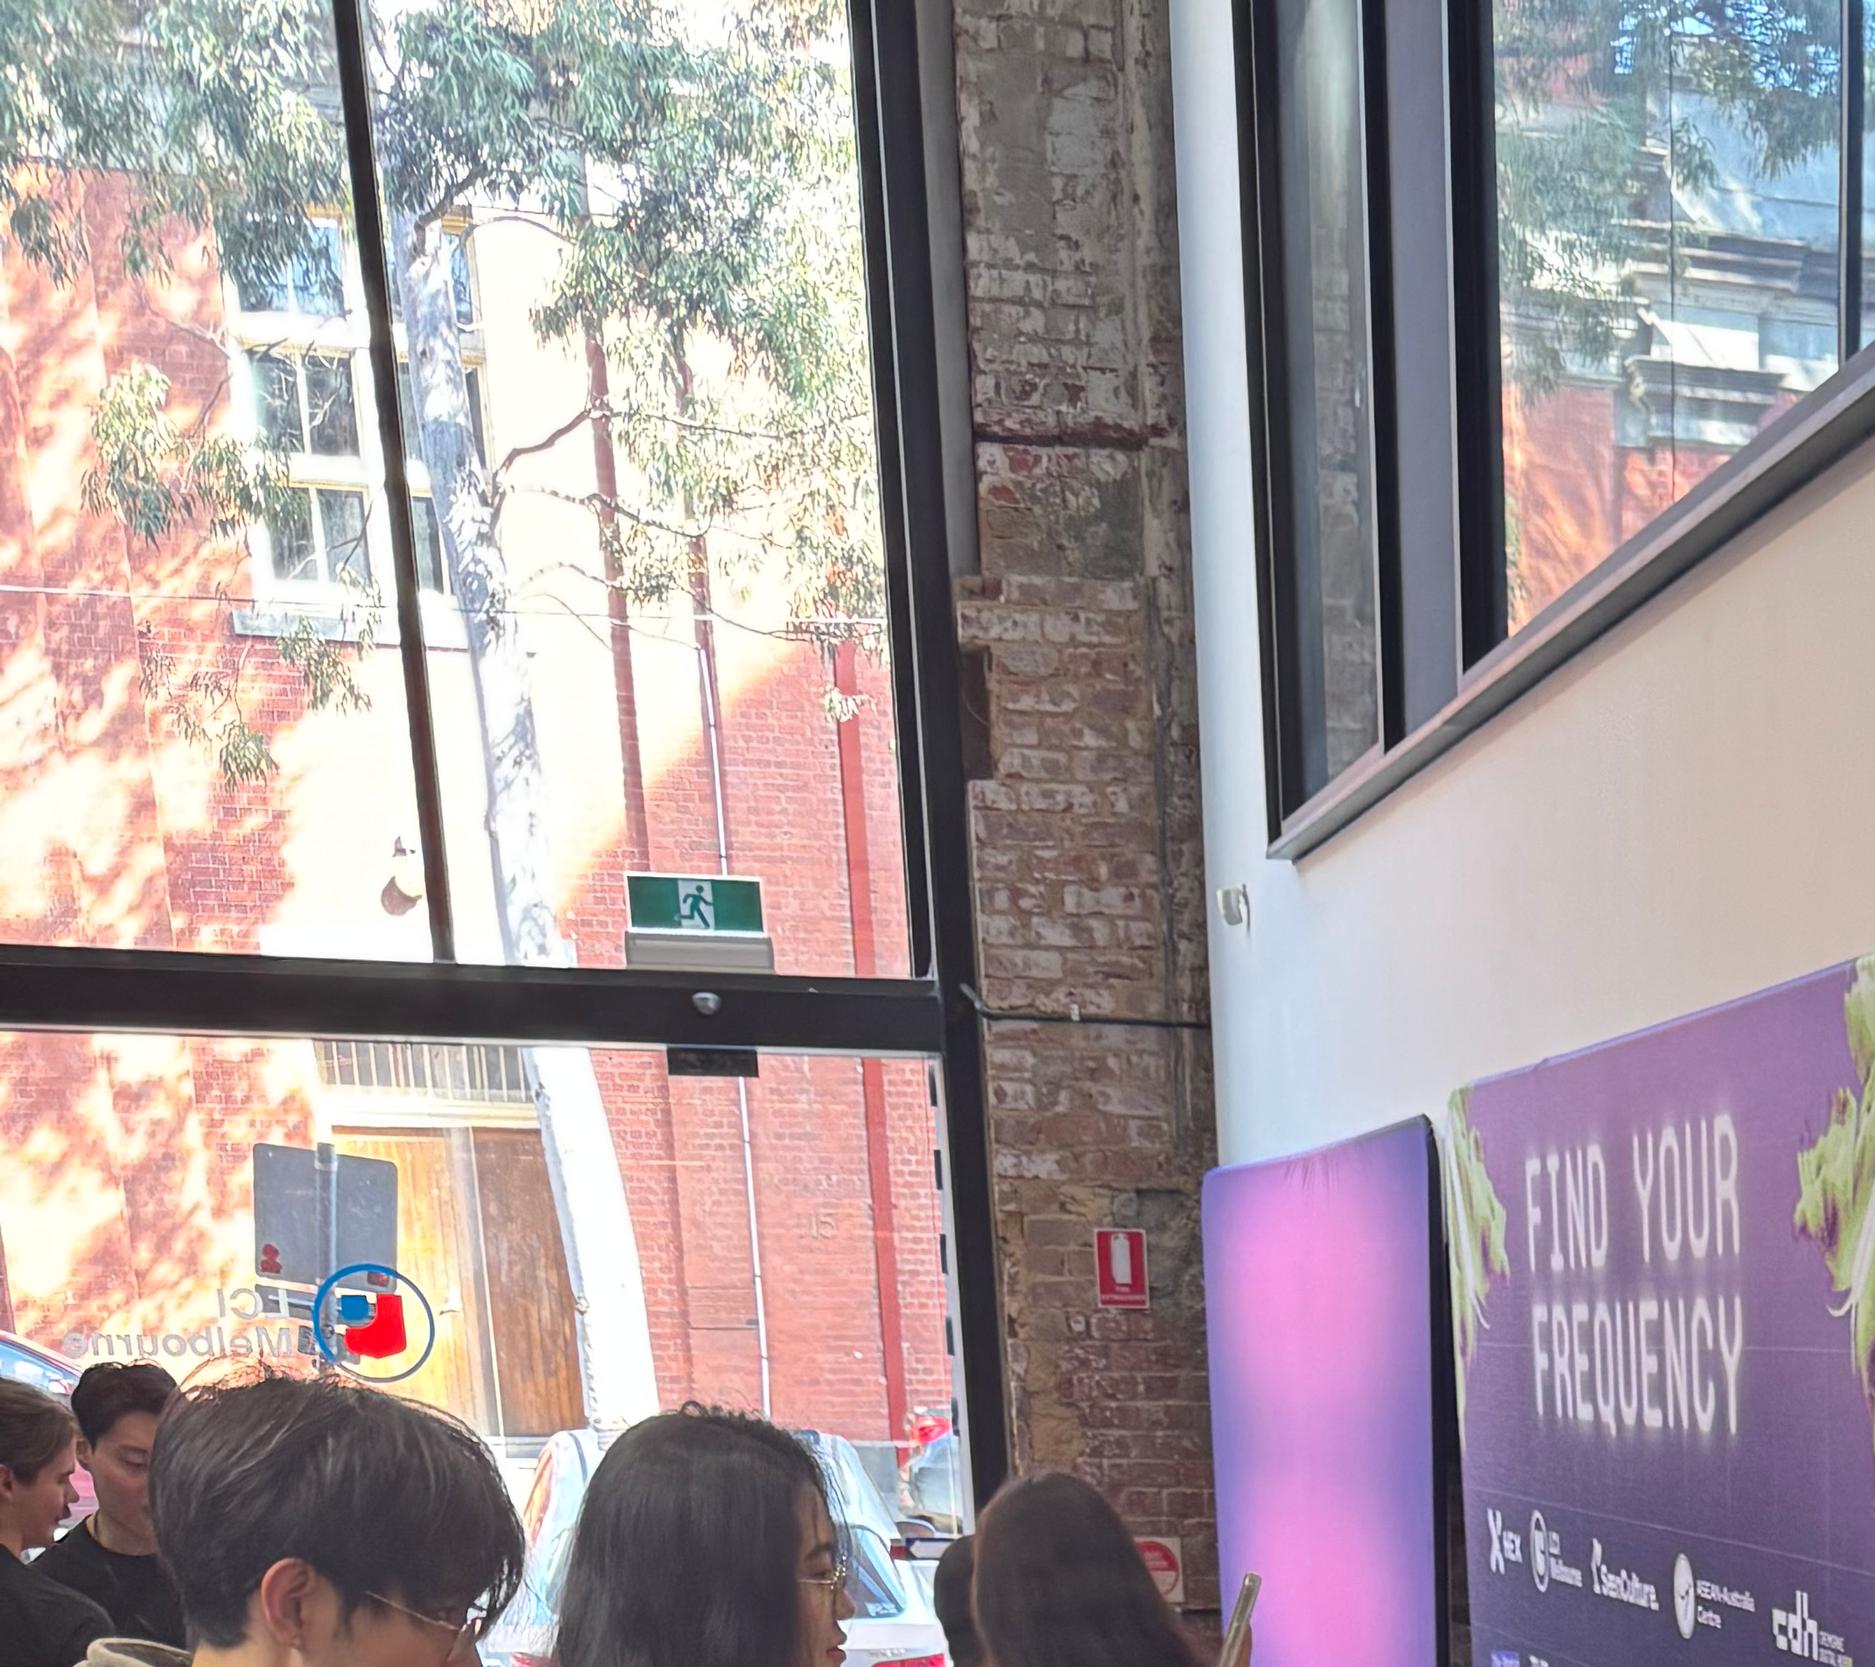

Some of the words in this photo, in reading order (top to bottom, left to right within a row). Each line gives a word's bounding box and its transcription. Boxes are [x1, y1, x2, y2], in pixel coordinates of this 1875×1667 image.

[1525, 1141, 1609, 1273] FIND
[1632, 1113, 1740, 1263] YOUR
[1532, 1295, 1743, 1437] FREQUENCY
